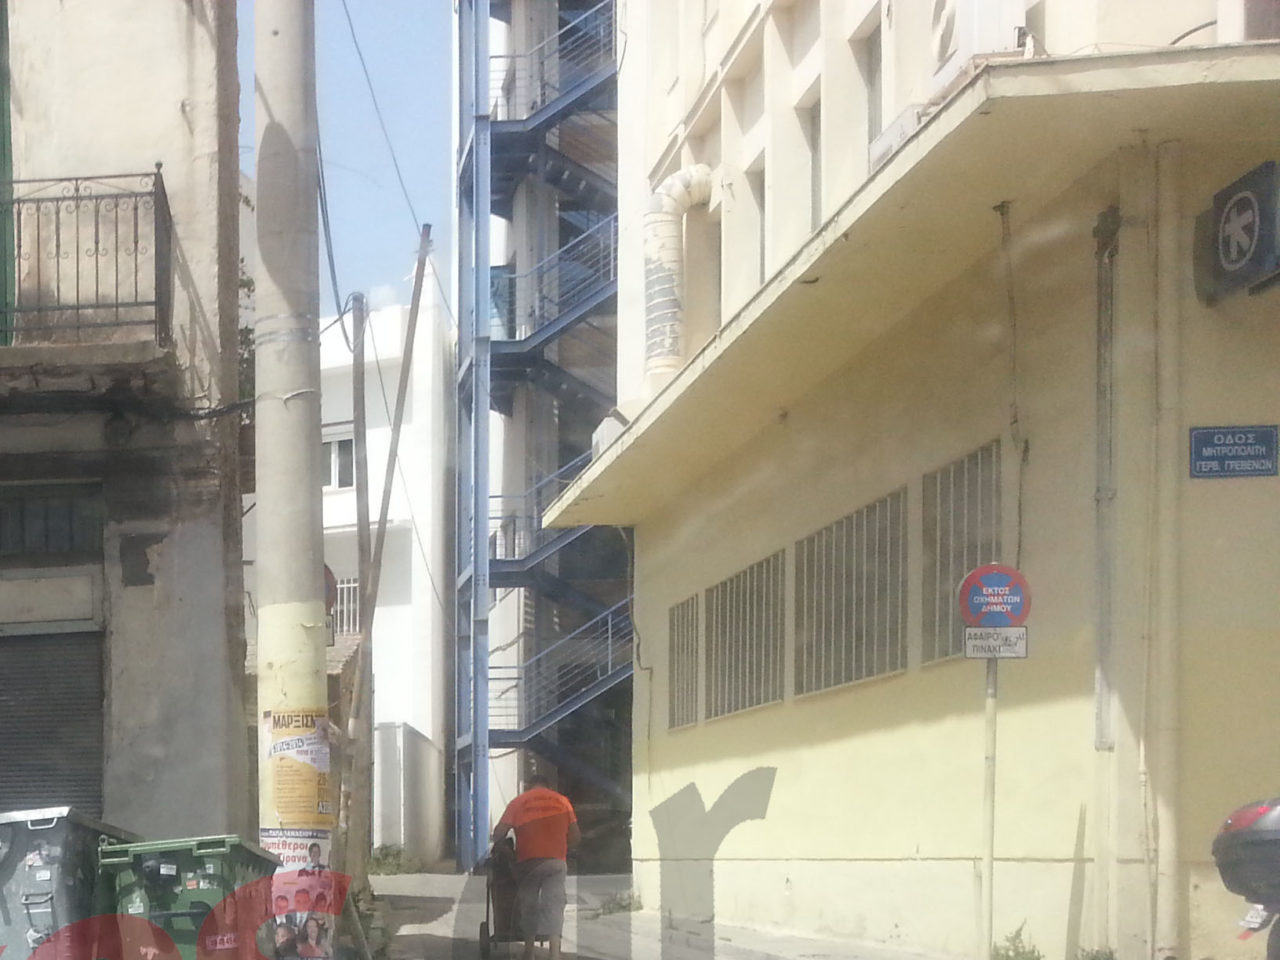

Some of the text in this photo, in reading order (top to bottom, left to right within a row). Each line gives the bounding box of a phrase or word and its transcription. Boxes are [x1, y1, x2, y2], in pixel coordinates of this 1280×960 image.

[1214, 433, 1256, 444] ΟΔΟΣ
[1202, 446, 1266, 457] ΜΗΤΡΟΠΟΛΙΤΗ
[982, 586, 1010, 595] ΕΚΤΟΣ
[973, 595, 1021, 604] ΟΧΗΜΑΤΩΝ
[981, 604, 1013, 613] ΔΗΜΟΥ
[972, 645, 1002, 655] ΠΙΝΑΚΙ
